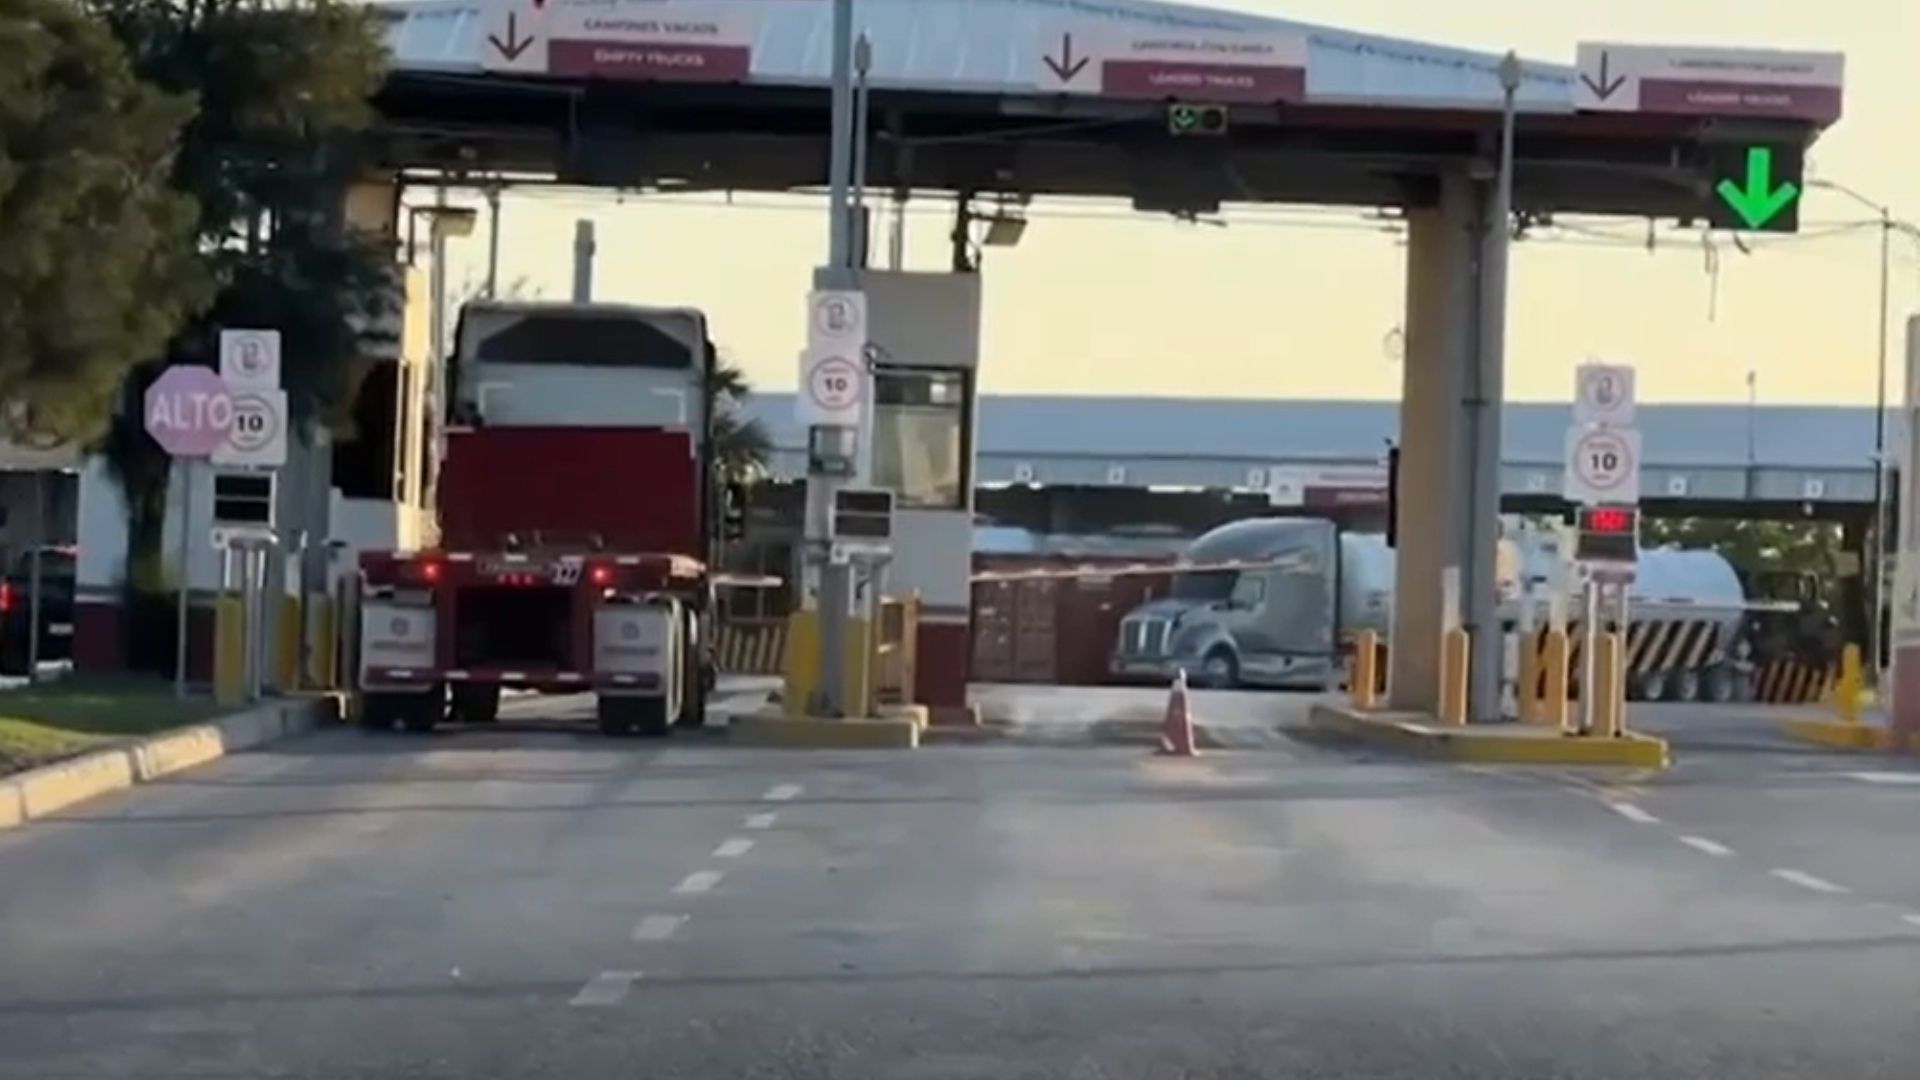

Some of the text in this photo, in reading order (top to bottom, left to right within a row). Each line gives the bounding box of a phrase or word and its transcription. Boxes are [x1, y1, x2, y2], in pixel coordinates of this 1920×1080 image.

[825, 377, 847, 392] 10
[151, 393, 234, 430] ALTO
[237, 413, 264, 432] 10
[1591, 453, 1618, 471] 10
